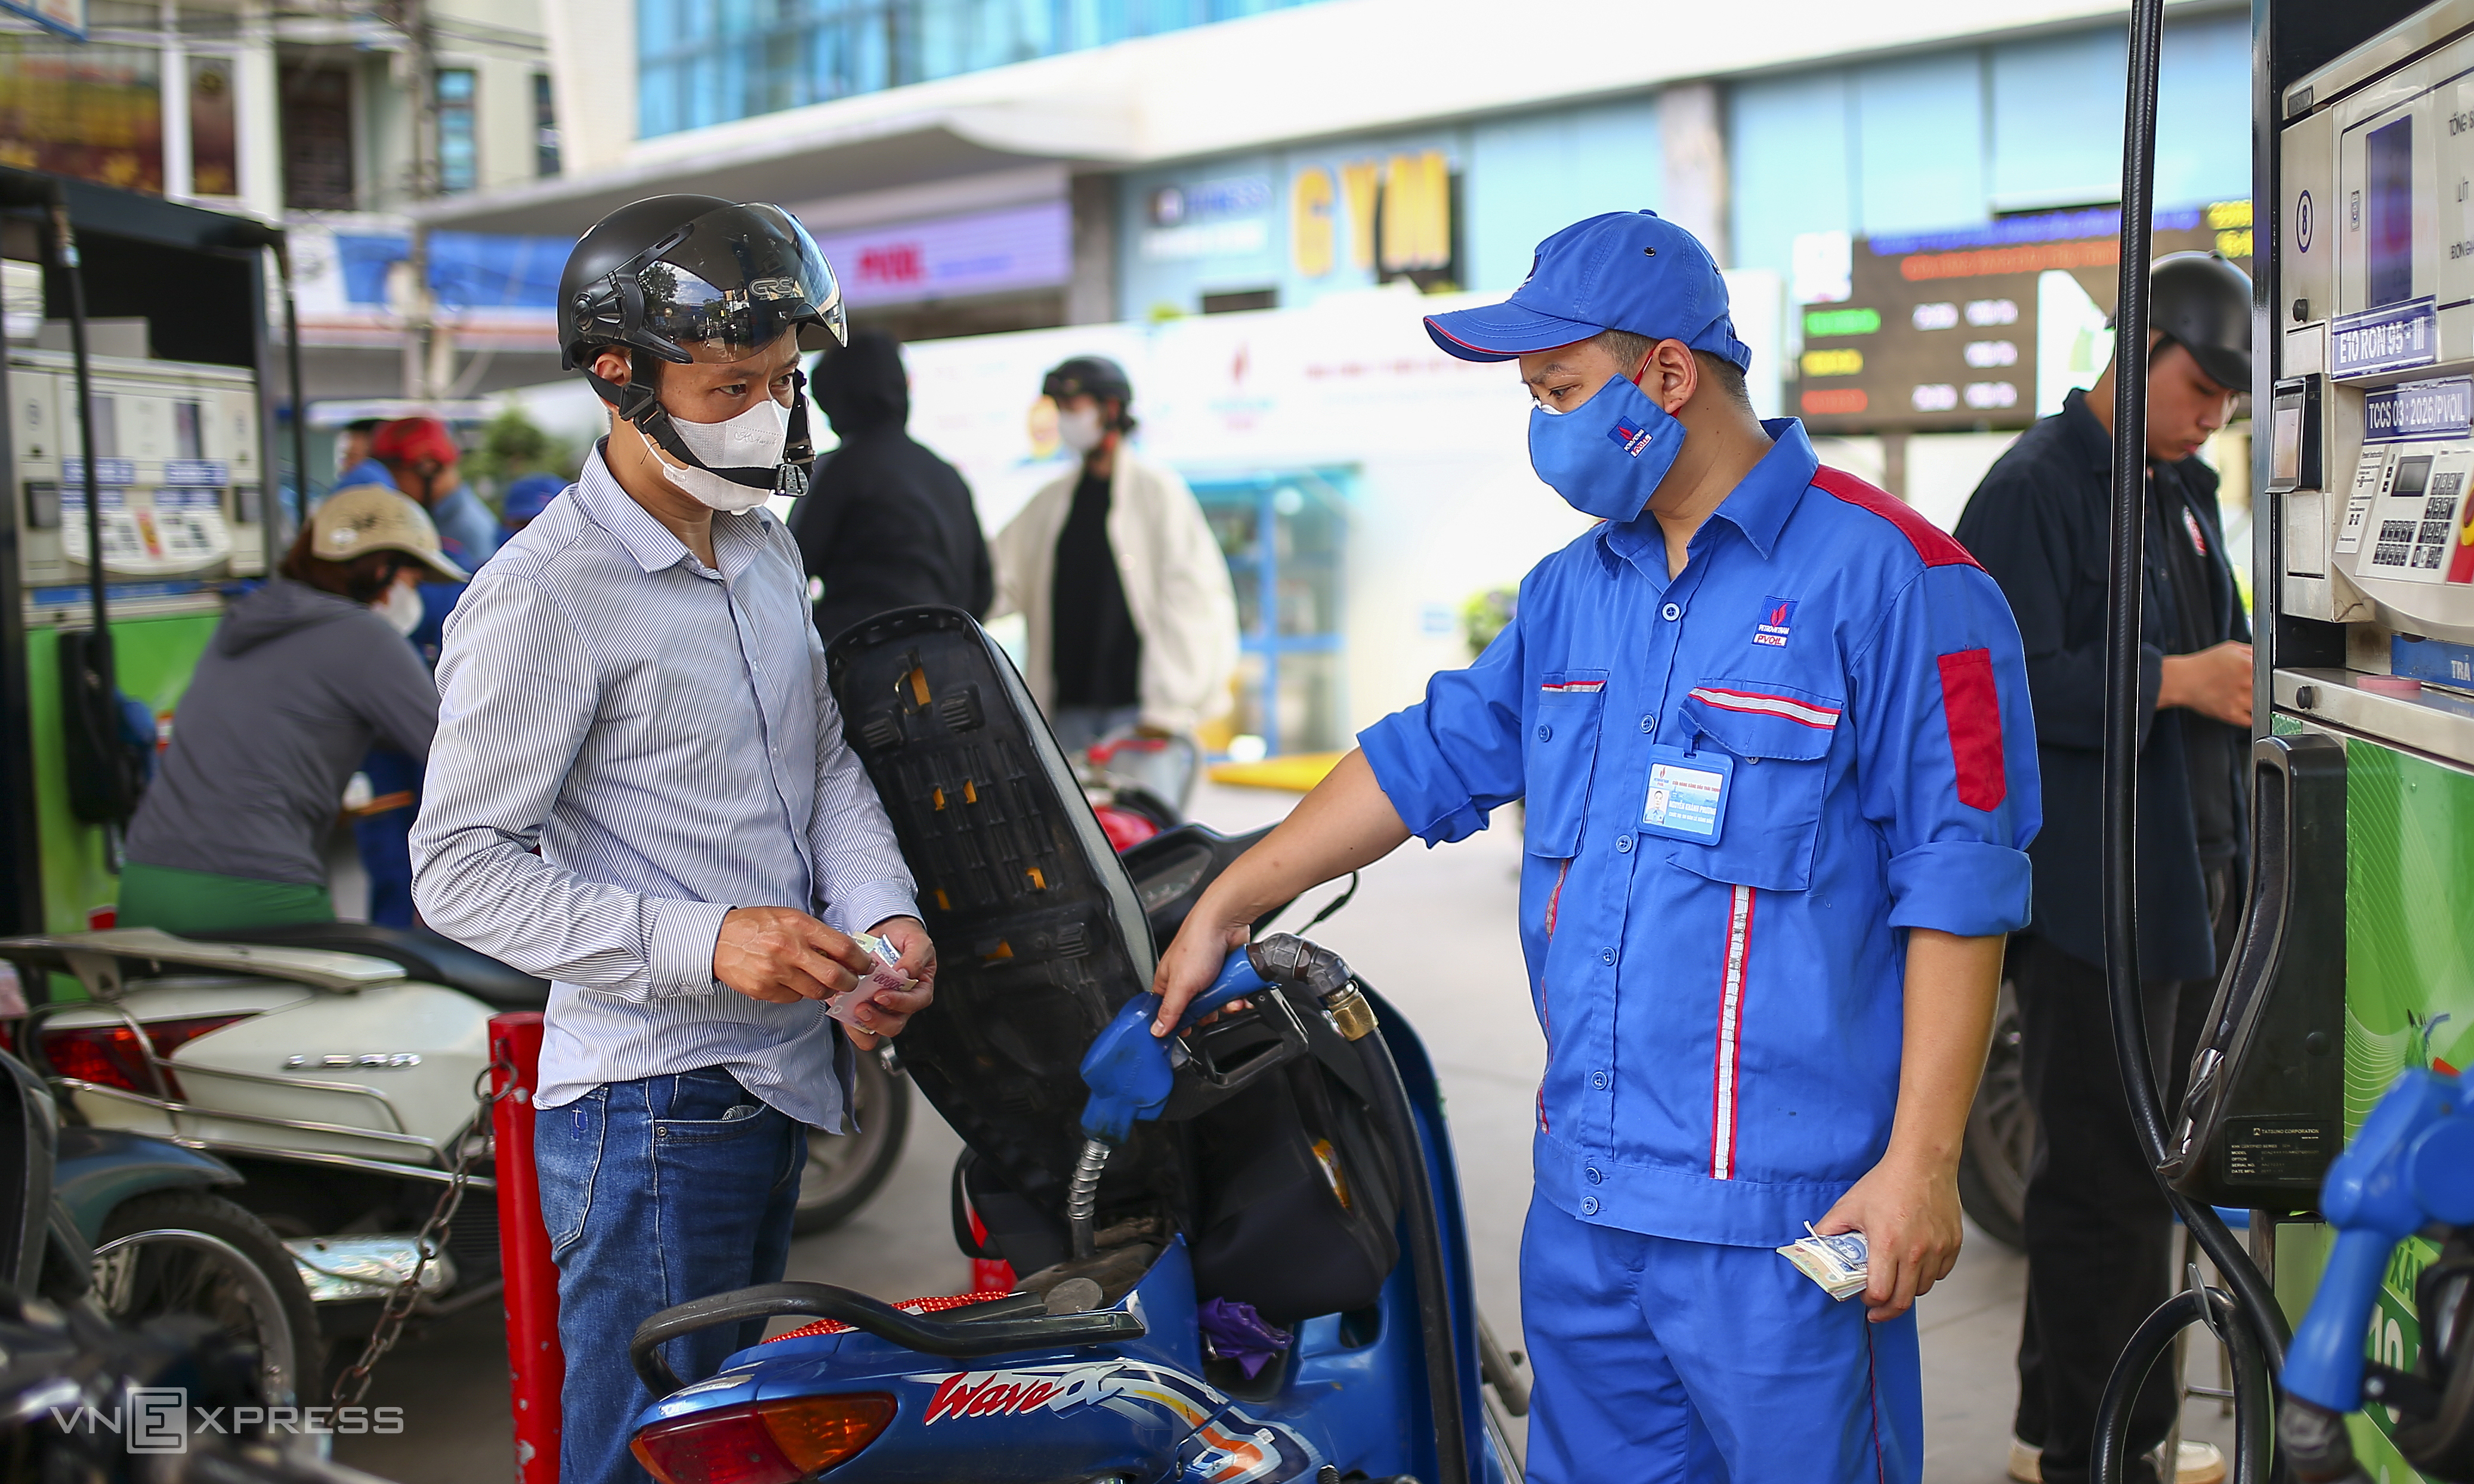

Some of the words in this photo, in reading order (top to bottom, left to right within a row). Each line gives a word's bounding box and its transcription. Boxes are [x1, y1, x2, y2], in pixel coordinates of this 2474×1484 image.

[2457, 176, 2469, 202] LÍT
[2340, 330, 2359, 363] E10
[2361, 325, 2386, 359] RON
[2387, 321, 2404, 354] 95
[2369, 401, 2391, 429] TCCS
[2393, 400, 2404, 426] 03
[2434, 475, 2440, 488] 7
[2428, 523, 2434, 536] 2
[2436, 524, 2442, 536] 3
[1758, 635, 1781, 645] PVOIL
[2451, 654, 2471, 681] TRẢ
[923, 1371, 1065, 1426] Wave
